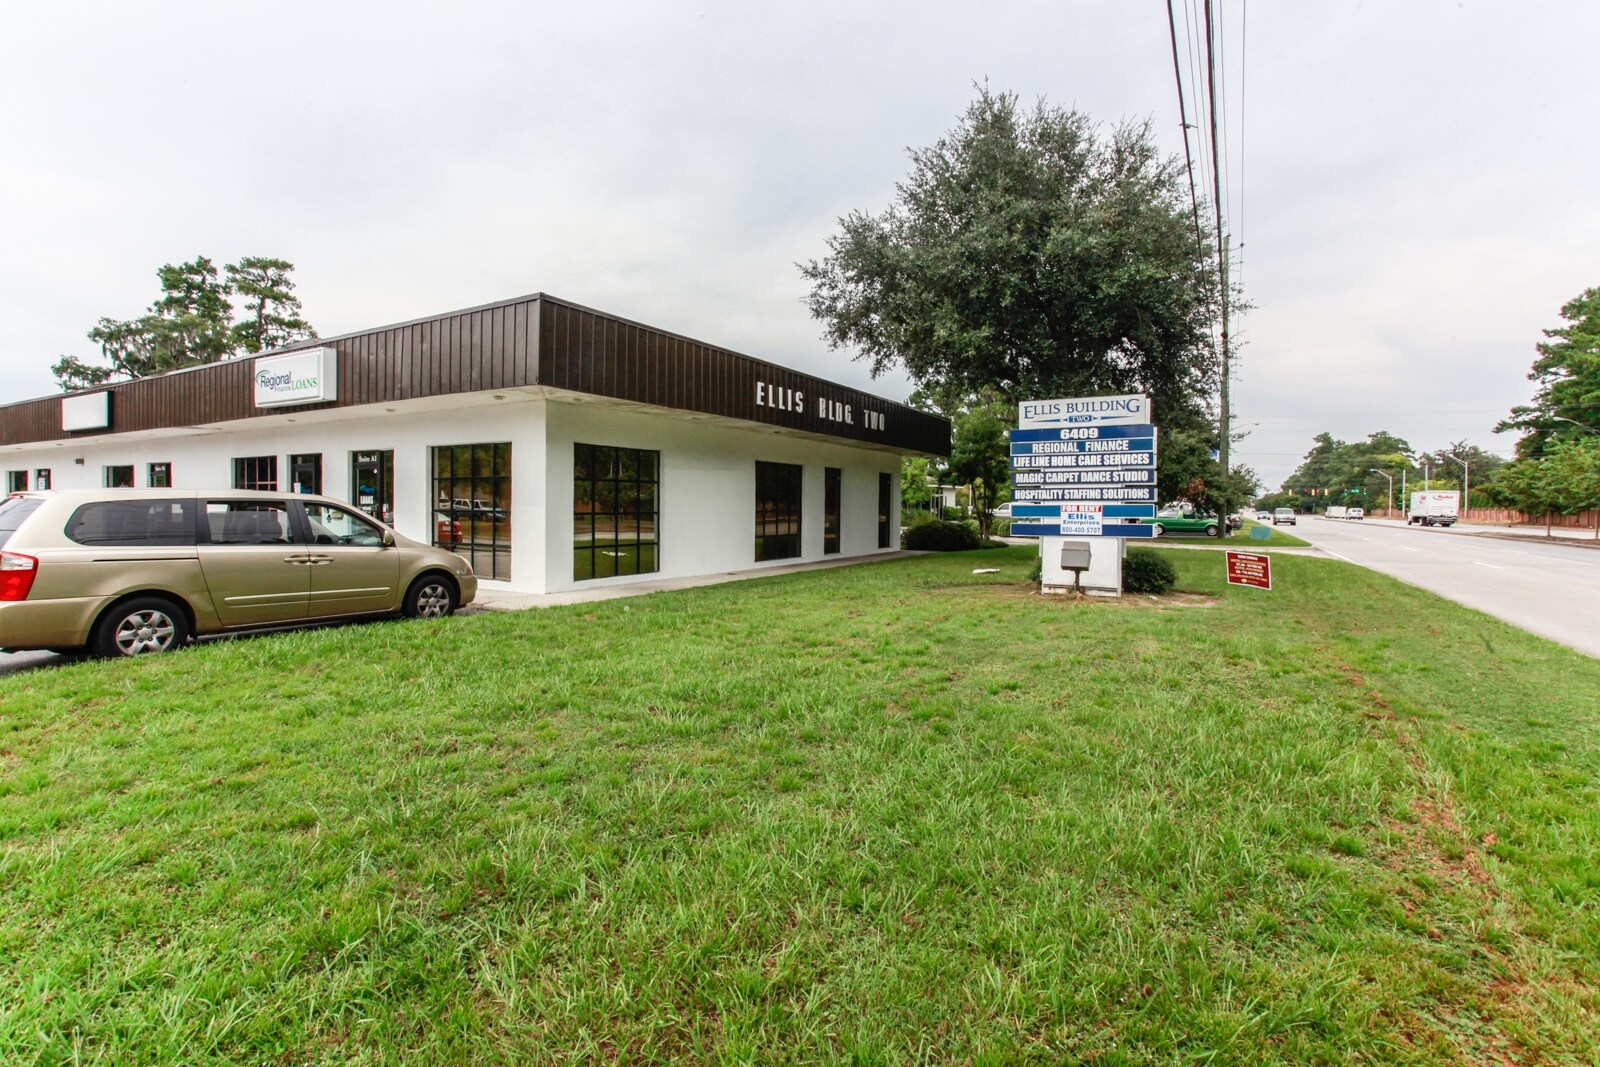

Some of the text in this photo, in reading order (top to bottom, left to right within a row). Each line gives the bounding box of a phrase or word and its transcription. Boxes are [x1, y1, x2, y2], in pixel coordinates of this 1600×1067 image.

[260, 371, 292, 390] Regional
[291, 377, 317, 390] LOANS
[756, 381, 885, 431] ELLIS BLDG. TWO
[1023, 399, 1140, 419] ELLIS BUILDING
[1070, 415, 1090, 423] TWO
[1060, 428, 1099, 440] 6409
[1032, 440, 1129, 454] REGIONAL FINANCE
[1013, 453, 1150, 467] LIFE LINE HOME CARE SERVICES
[1015, 470, 1149, 483] MAGIC CARPET DANCE STUDIO
[1015, 488, 1150, 500] HOSPITALITY STAFFING SOLUTIONS
